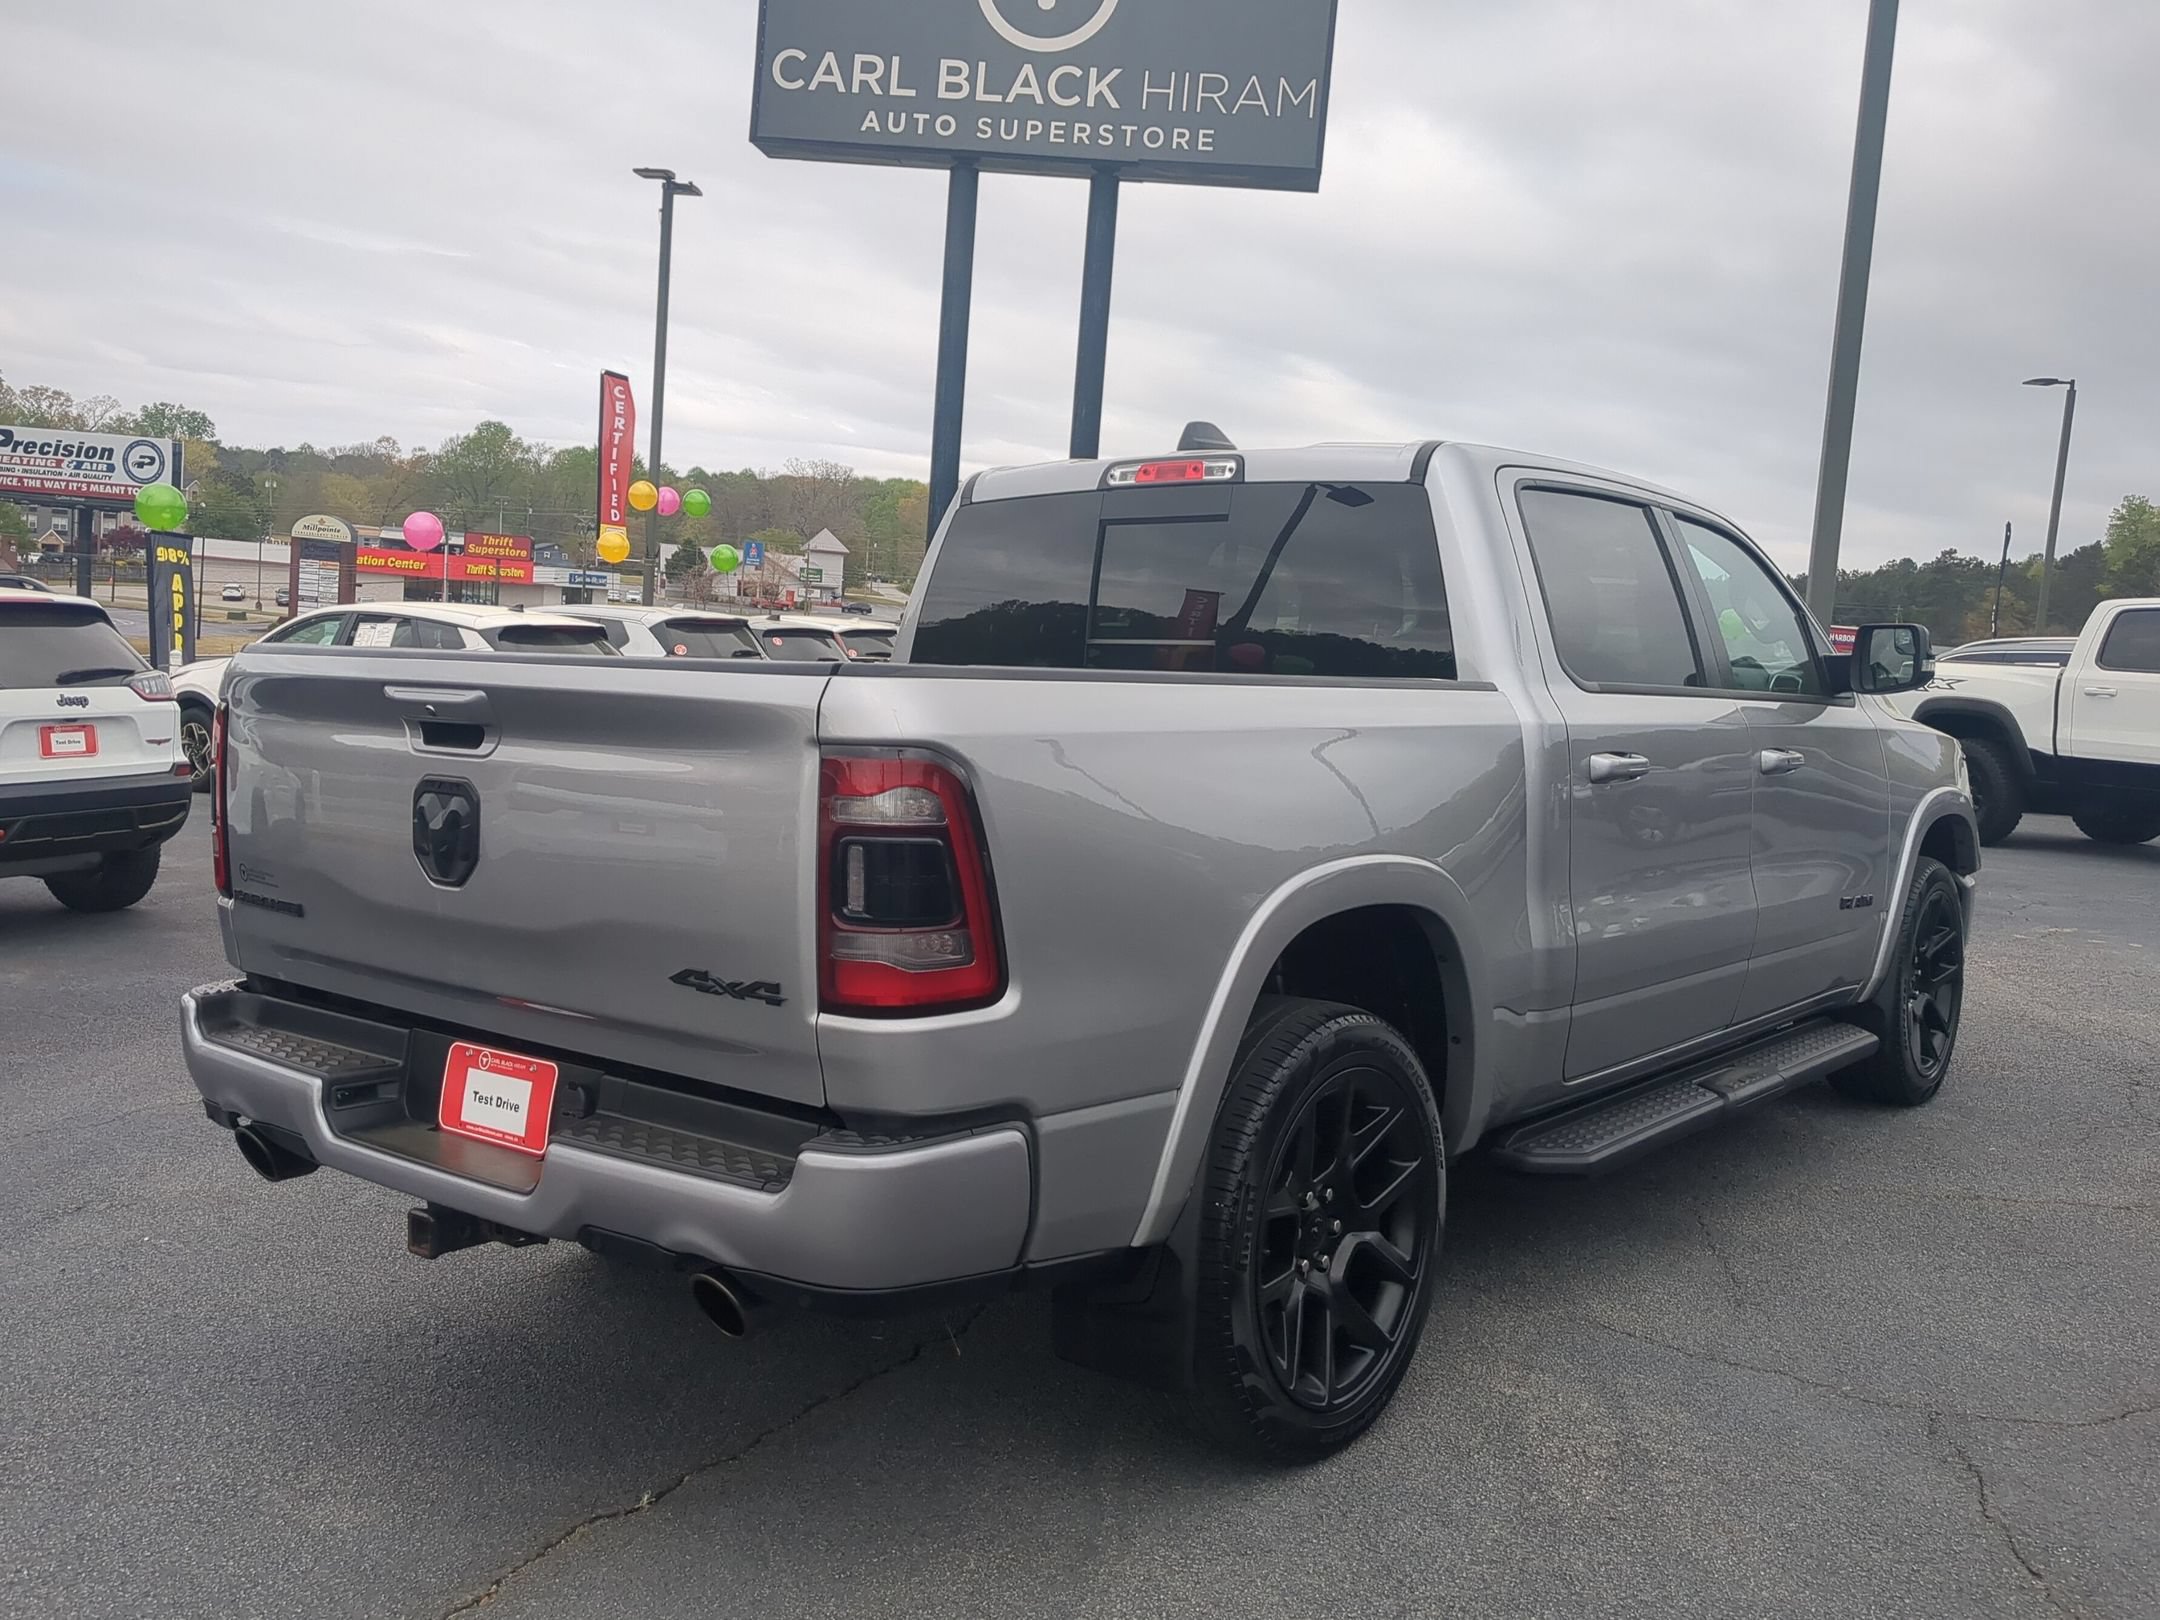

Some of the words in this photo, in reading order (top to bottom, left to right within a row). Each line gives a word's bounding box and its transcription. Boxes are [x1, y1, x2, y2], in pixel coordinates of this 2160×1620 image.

[771, 48, 917, 97] CARL
[937, 58, 1123, 109] BLACK
[1141, 69, 1318, 119] HIRAM
[859, 110, 957, 137] AUTO
[975, 117, 1216, 151] SUPERSTORE
[610, 386, 626, 522] CERTIFIED
[0, 455, 57, 467] EATING
[81, 462, 108, 473] AIR
[21, 467, 63, 478] INSULATION
[0, 475, 21, 486] VICE.
[23, 478, 41, 488] THE
[43, 480, 66, 490] WAY
[68, 482, 88, 492] IT'S
[90, 485, 125, 495] MEANT
[302, 524, 341, 534] Millpointe
[481, 535, 513, 547] Thrift
[468, 543, 528, 558] Superstore
[356, 556, 385, 567] ation
[387, 557, 426, 571] Center
[466, 564, 487, 575] Thrift
[487, 565, 525, 578] Suerstore
[171, 573, 184, 651] APPR
[57, 694, 89, 708] Jeep
[473, 1090, 493, 1107] Test
[496, 1096, 520, 1113] Drive
